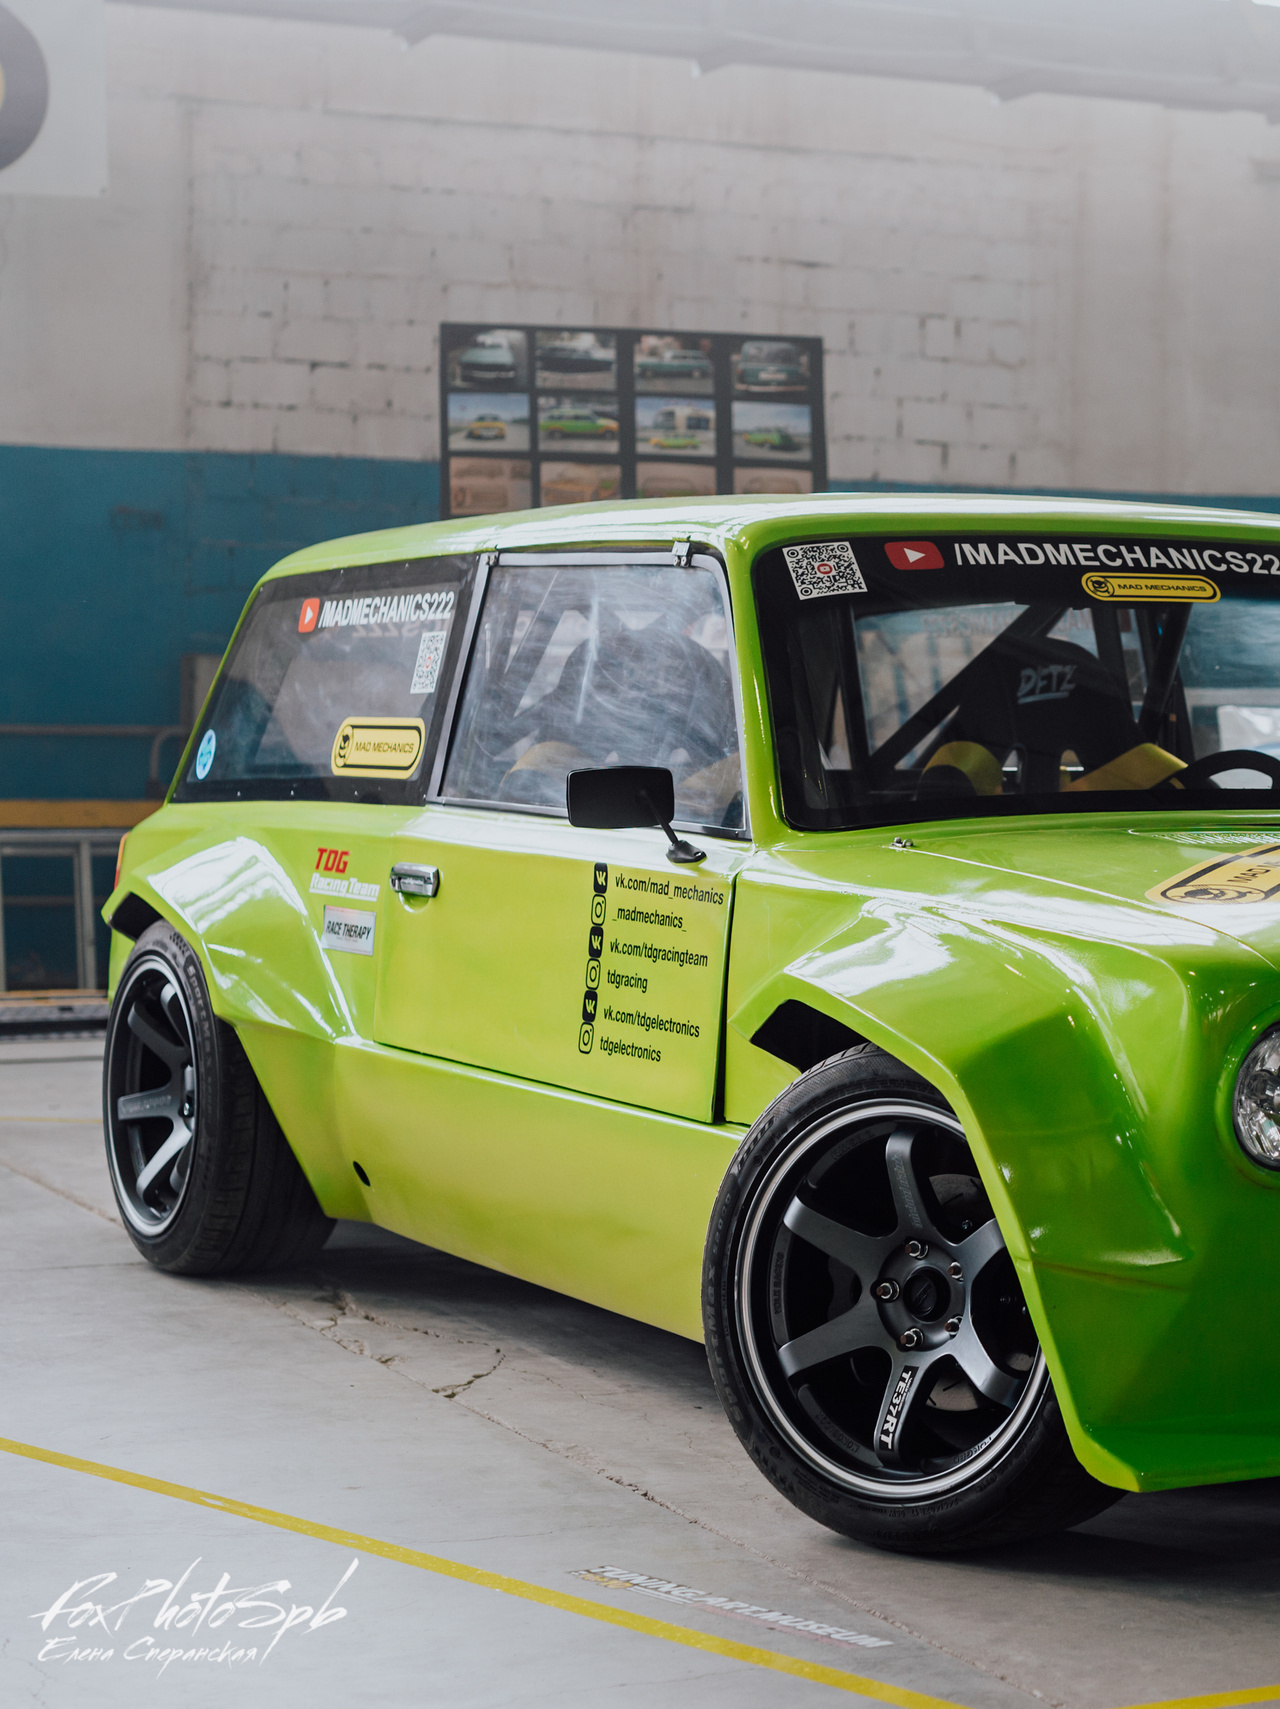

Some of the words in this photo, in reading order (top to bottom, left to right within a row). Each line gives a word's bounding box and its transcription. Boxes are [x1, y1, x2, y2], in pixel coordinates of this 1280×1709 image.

[1117, 583, 1143, 591] MAD
[1144, 584, 1207, 592] MECHANICS
[354, 740, 373, 753] MAD
[373, 741, 415, 754] MECHANICS
[310, 872, 349, 897] Racing
[348, 877, 381, 899] Team
[615, 873, 725, 905] vk.com/mad_mechanics
[326, 920, 343, 937] RACE
[342, 923, 372, 940] THERAPY
[612, 906, 687, 932] _madmechanics_
[610, 938, 708, 967] vk.com/tdgracingteam
[607, 969, 648, 993] tdgracing
[603, 1005, 700, 1037] vk.com/tdgelectronics
[599, 1036, 662, 1062] tdgelectronics
[880, 1370, 912, 1450] TE37RT
